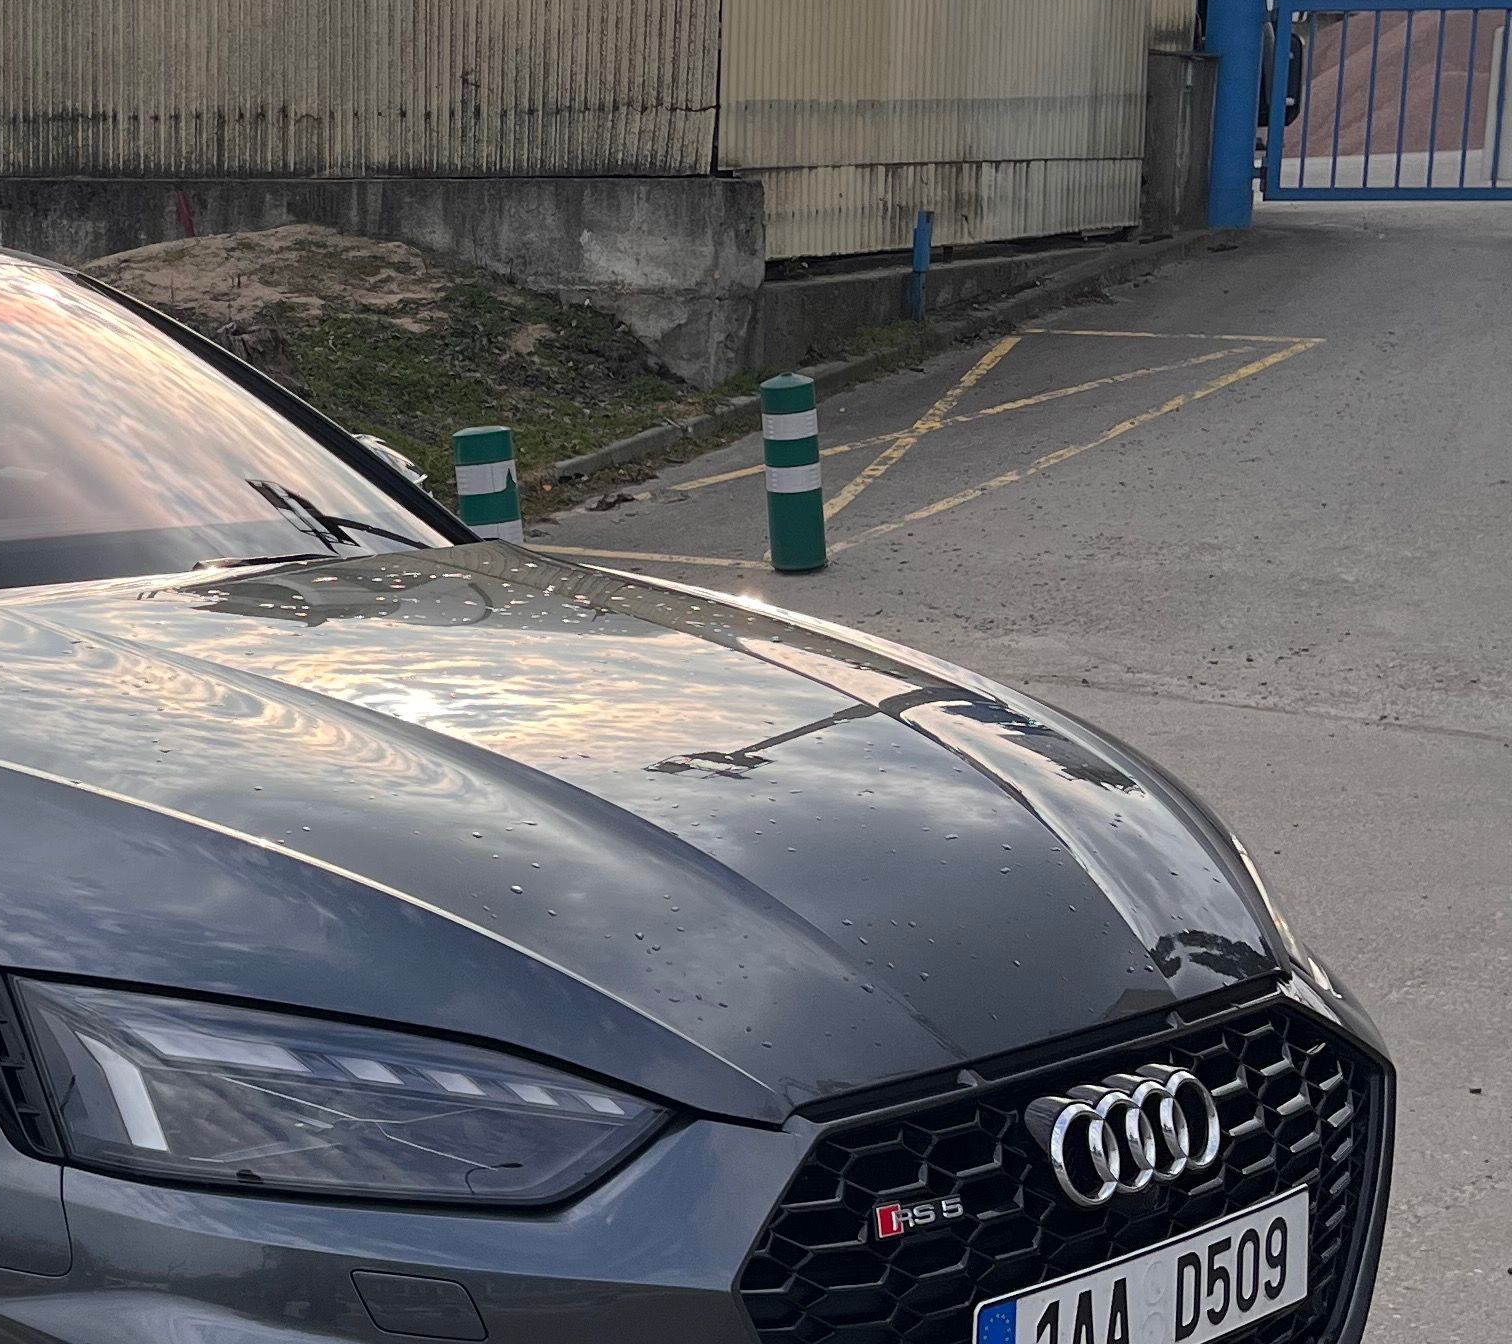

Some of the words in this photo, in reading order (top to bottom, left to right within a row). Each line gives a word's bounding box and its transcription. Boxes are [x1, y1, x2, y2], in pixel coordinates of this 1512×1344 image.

[888, 1204, 936, 1233] RS
[941, 1197, 964, 1218] 5
[1175, 1216, 1288, 1343] D509
